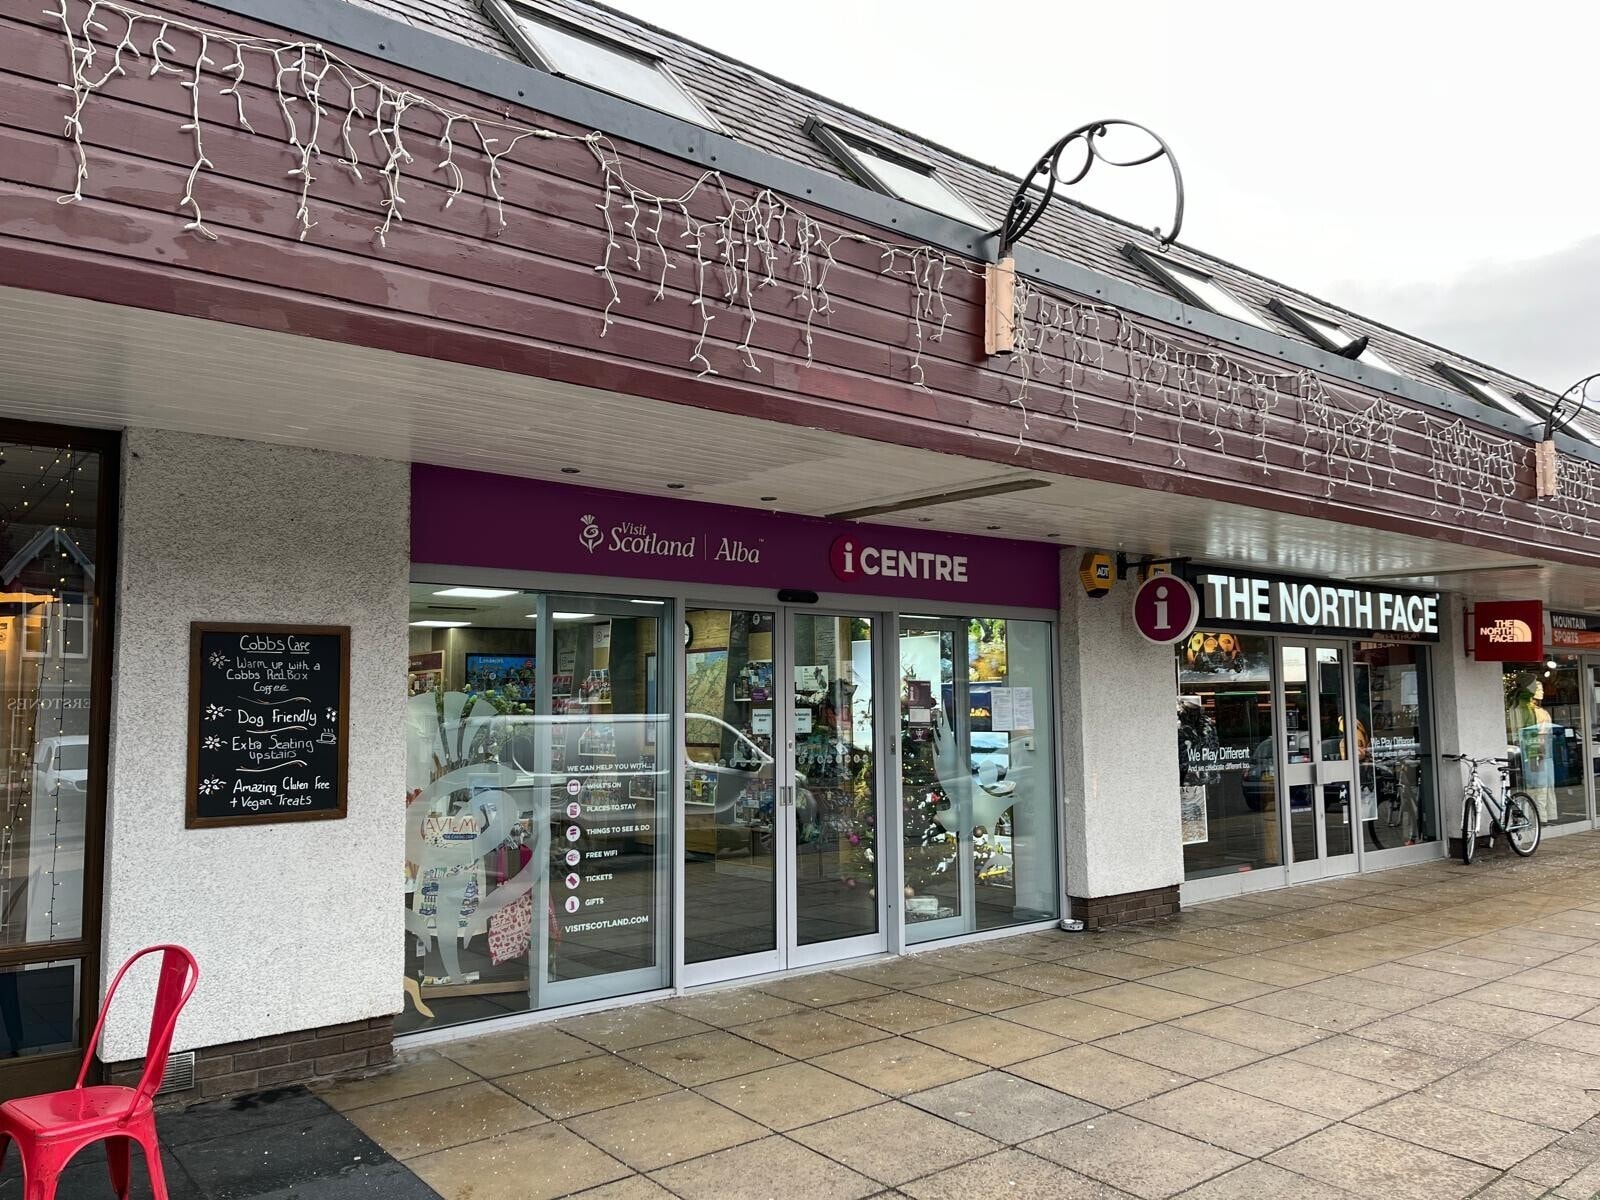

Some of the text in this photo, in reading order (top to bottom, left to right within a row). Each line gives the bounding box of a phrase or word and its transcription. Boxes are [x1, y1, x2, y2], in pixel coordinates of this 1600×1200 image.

[622, 521, 647, 536] Visit
[608, 526, 760, 563] Scotland Alba
[860, 546, 968, 582] CENTRE
[1096, 566, 1109, 577] ADT
[1206, 573, 1438, 634] THE NORTH FACE
[1494, 619, 1514, 627] THE
[1552, 615, 1587, 630] MOUNTAIN
[1480, 627, 1514, 635] NORTH
[1489, 634, 1514, 643] FACE
[1554, 630, 1579, 644] SPORTS
[239, 634, 311, 651] Cobbs Cafe
[236, 656, 321, 671] Warm up with a
[226, 668, 309, 681] Cobbs Red Box
[253, 681, 290, 695] Coffee
[238, 708, 264, 727] Dog
[232, 734, 314, 753] Extra Seating
[249, 749, 297, 764] upstairs
[1187, 747, 1200, 761] We
[1201, 747, 1218, 763] Play
[232, 778, 278, 796] Amazing
[241, 796, 273, 811] Vegan
[276, 793, 312, 806] Treats
[586, 804, 611, 812] PLACES
[586, 827, 611, 835] THINGS
[585, 850, 618, 859] FREE WIFI
[585, 873, 613, 882] TICKETS
[584, 897, 605, 906] GIFTS
[564, 915, 649, 934] VISITSCOTLAND.COM
